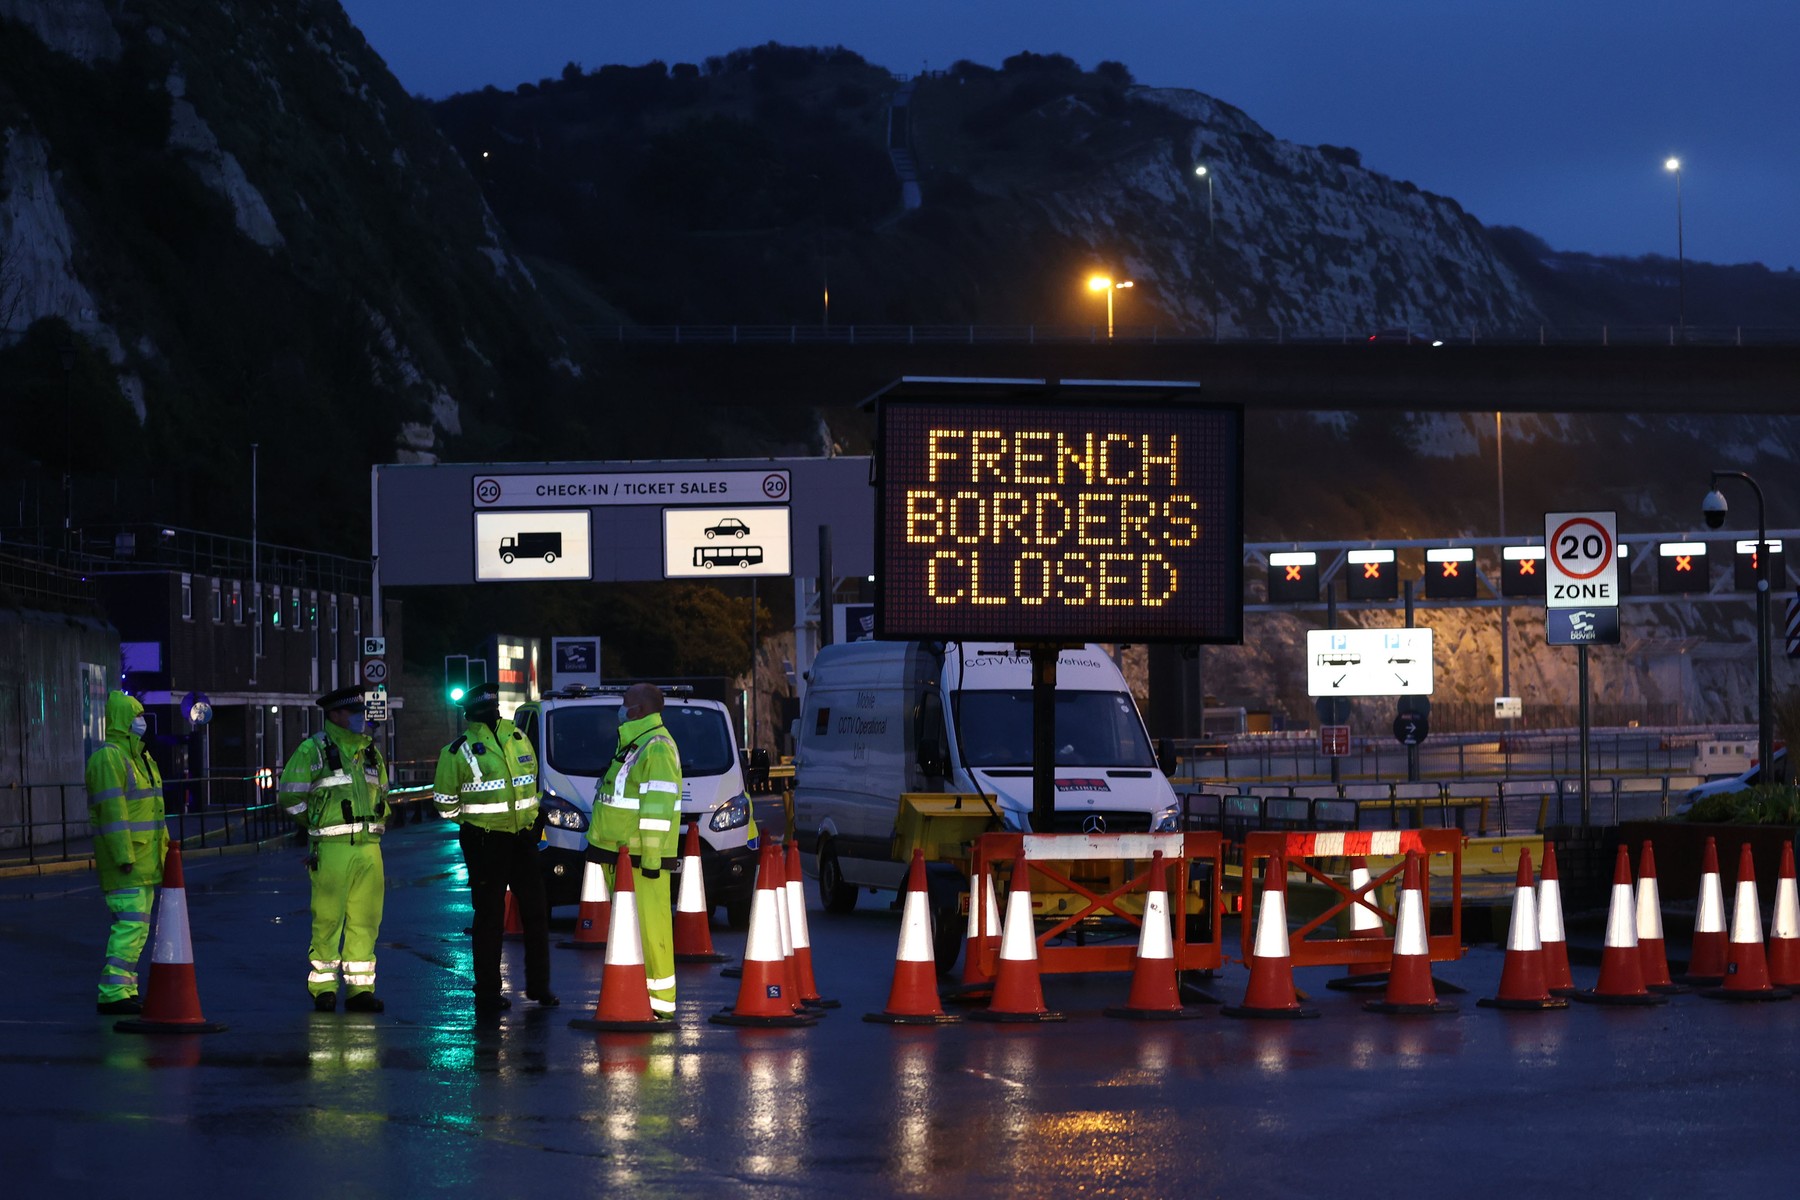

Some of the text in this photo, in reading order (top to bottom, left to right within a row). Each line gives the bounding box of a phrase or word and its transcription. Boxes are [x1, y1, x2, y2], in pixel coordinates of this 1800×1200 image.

[929, 429, 1177, 486] FRENCH
[480, 486, 498, 497] 20
[536, 484, 608, 496] CHECK-IN
[624, 483, 675, 494] TICKET
[680, 482, 728, 493] SALES
[766, 481, 784, 492] 20
[906, 490, 1198, 547] BORDERS
[1560, 535, 1603, 559] 20
[928, 550, 1177, 607] CLOSED
[1554, 584, 1610, 599] ZONE
[366, 664, 386, 678] 20
[964, 657, 1004, 668] CCTV
[1057, 657, 1101, 668] Vehicle
[856, 691, 876, 709] Mobile
[838, 716, 888, 734] CCTV Operational
[853, 741, 866, 760] Unit
